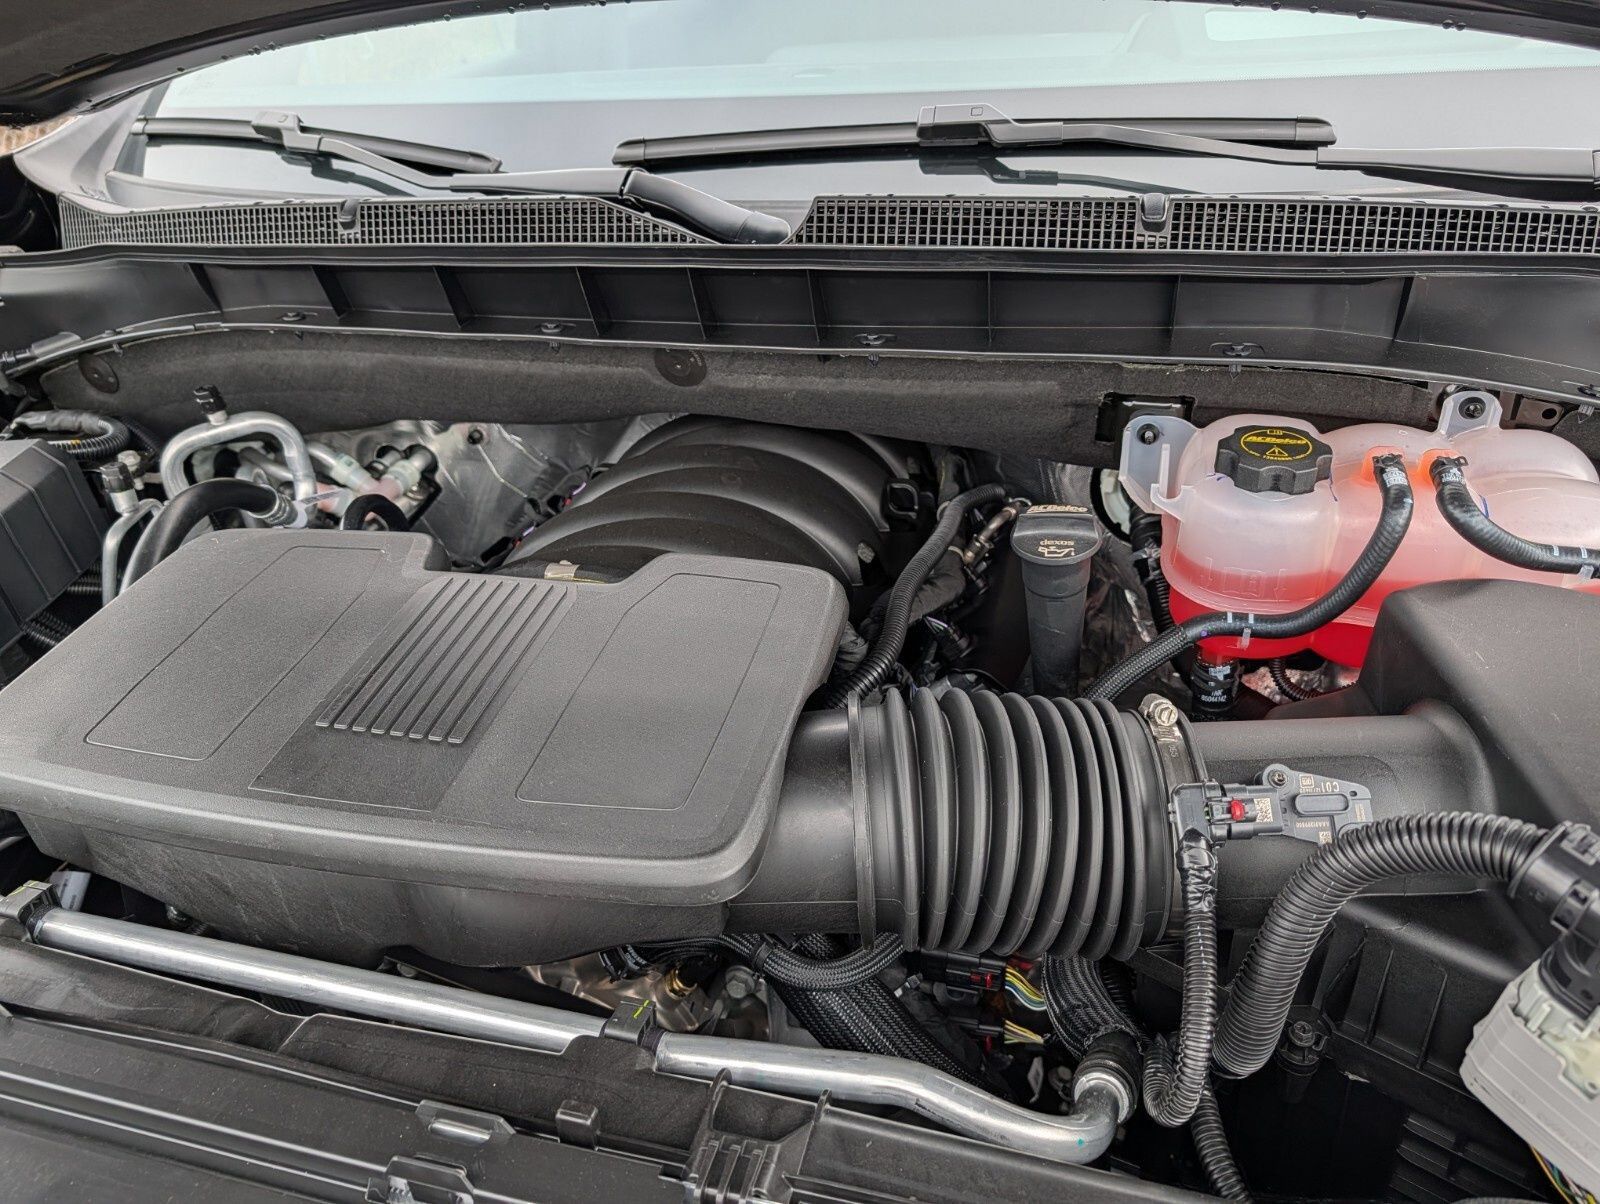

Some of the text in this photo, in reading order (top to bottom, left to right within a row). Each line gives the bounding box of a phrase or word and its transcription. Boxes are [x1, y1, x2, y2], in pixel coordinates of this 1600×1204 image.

[1244, 436, 1307, 445] ACDelco
[1026, 504, 1088, 514] ACDelco
[1321, 781, 1340, 793] C01
